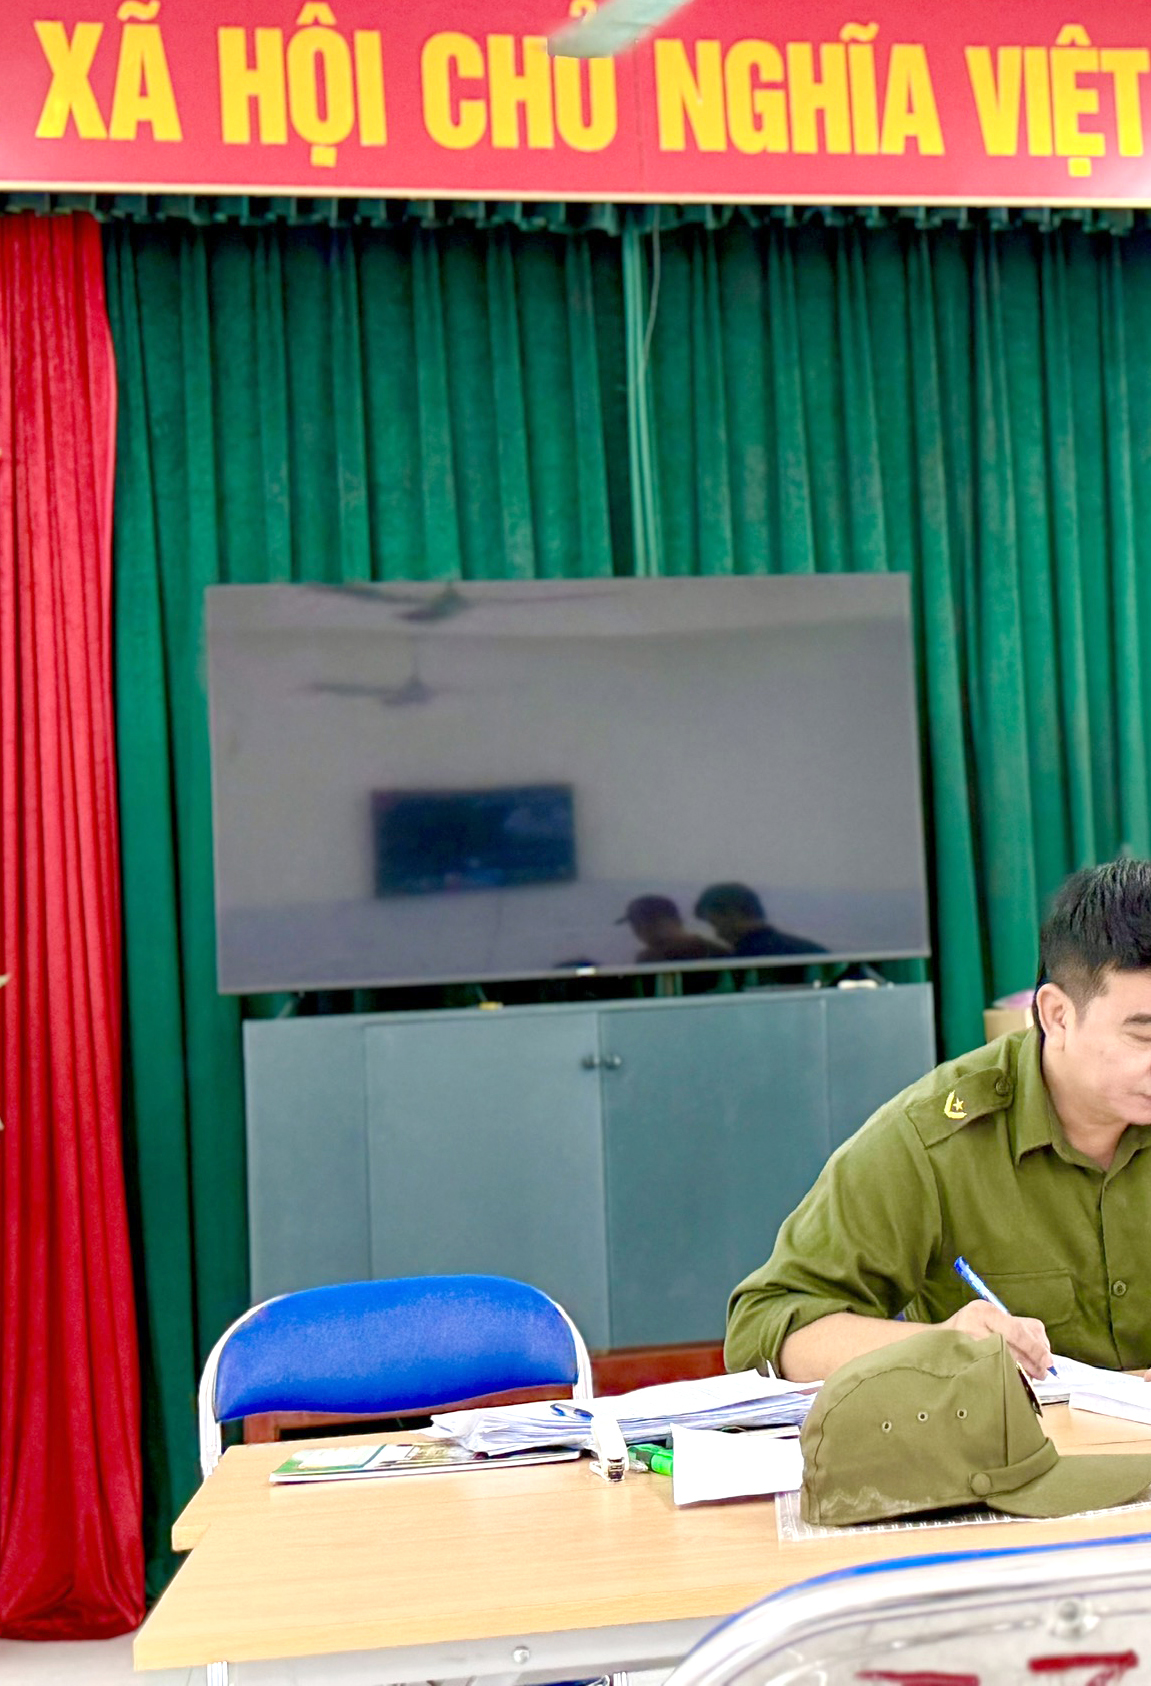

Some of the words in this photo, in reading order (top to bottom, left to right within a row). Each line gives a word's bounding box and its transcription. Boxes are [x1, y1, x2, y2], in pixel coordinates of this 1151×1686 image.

[34, 1, 183, 142] XÃ
[217, 2, 387, 167] HỘI
[421, 0, 617, 152] CHỦ
[653, 22, 946, 156] NGHĨA
[965, 25, 1150, 178] VIỆT
